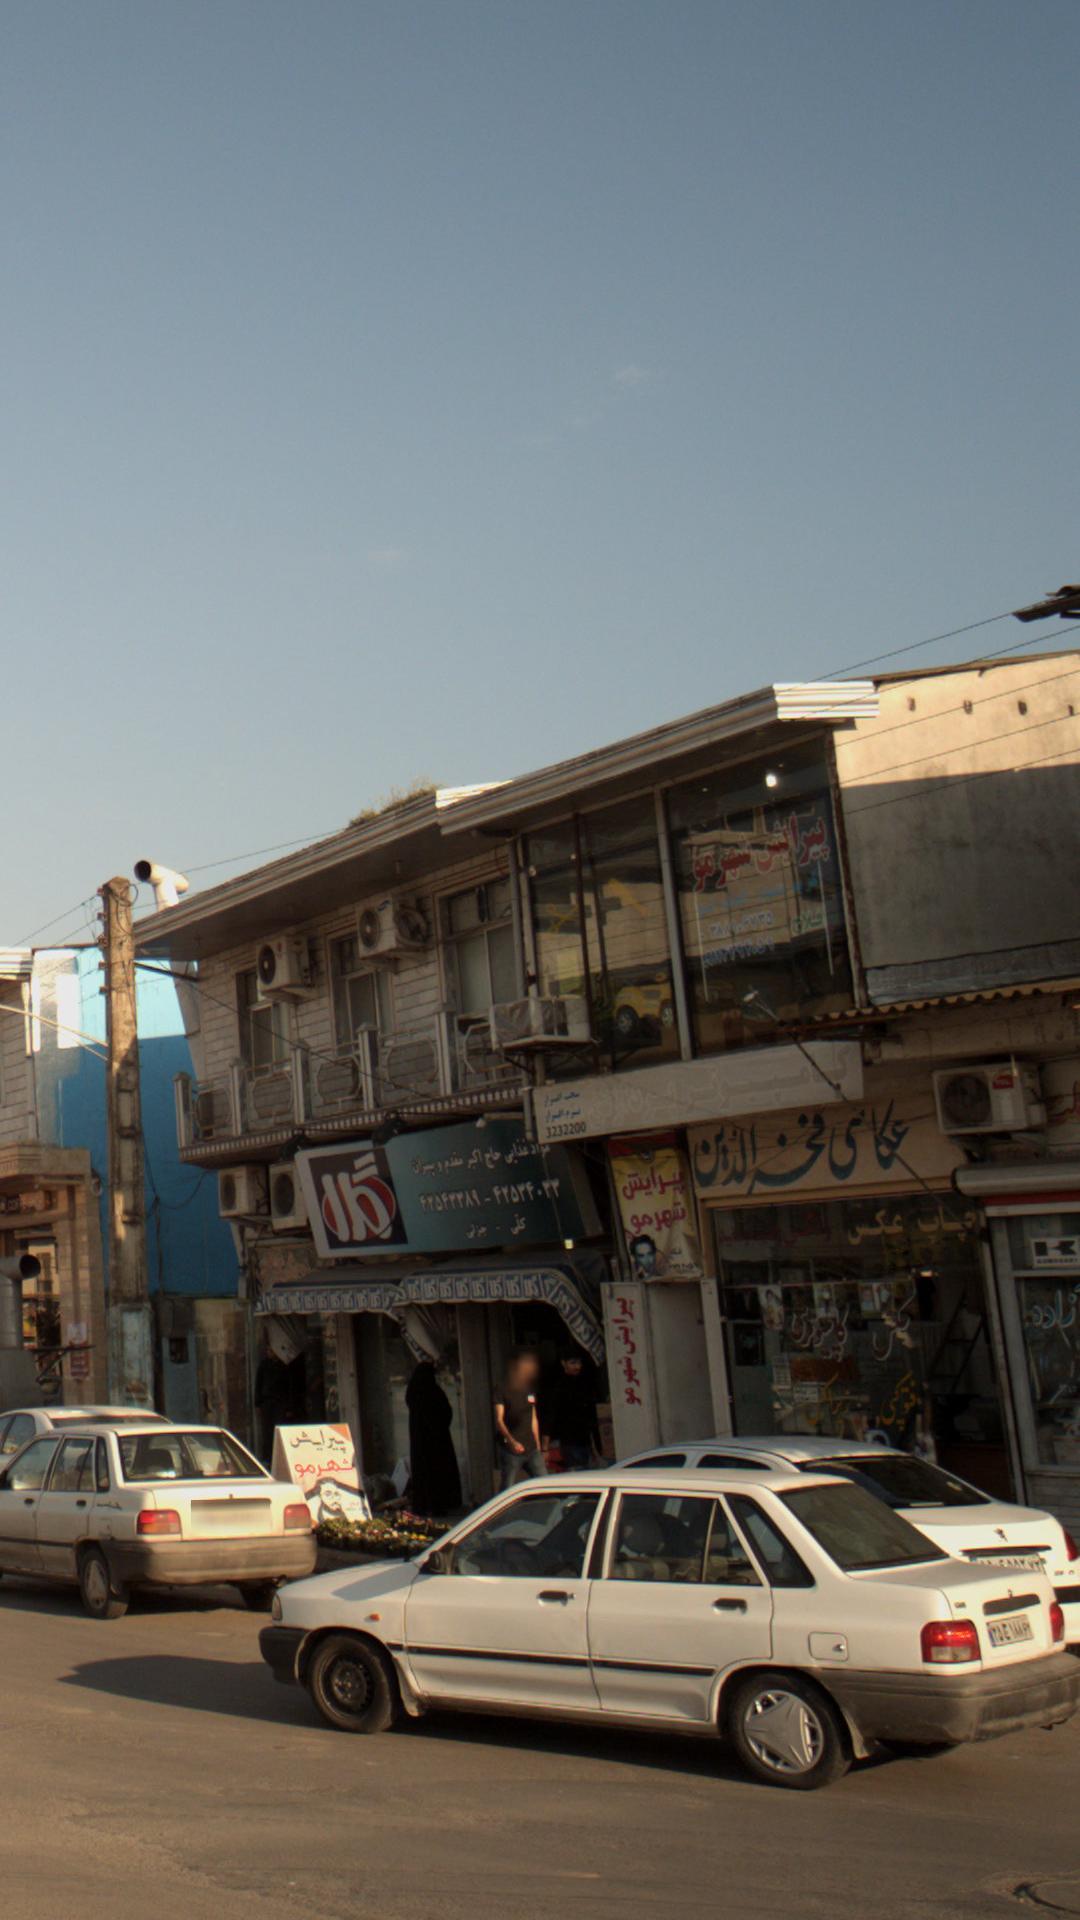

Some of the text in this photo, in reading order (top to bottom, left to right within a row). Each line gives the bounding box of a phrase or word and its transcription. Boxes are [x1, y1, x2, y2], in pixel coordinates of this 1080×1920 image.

[621, 1166, 686, 1202] پیرایش
[848, 1206, 904, 1244] عکس
[290, 1429, 347, 1454] پیرایش
